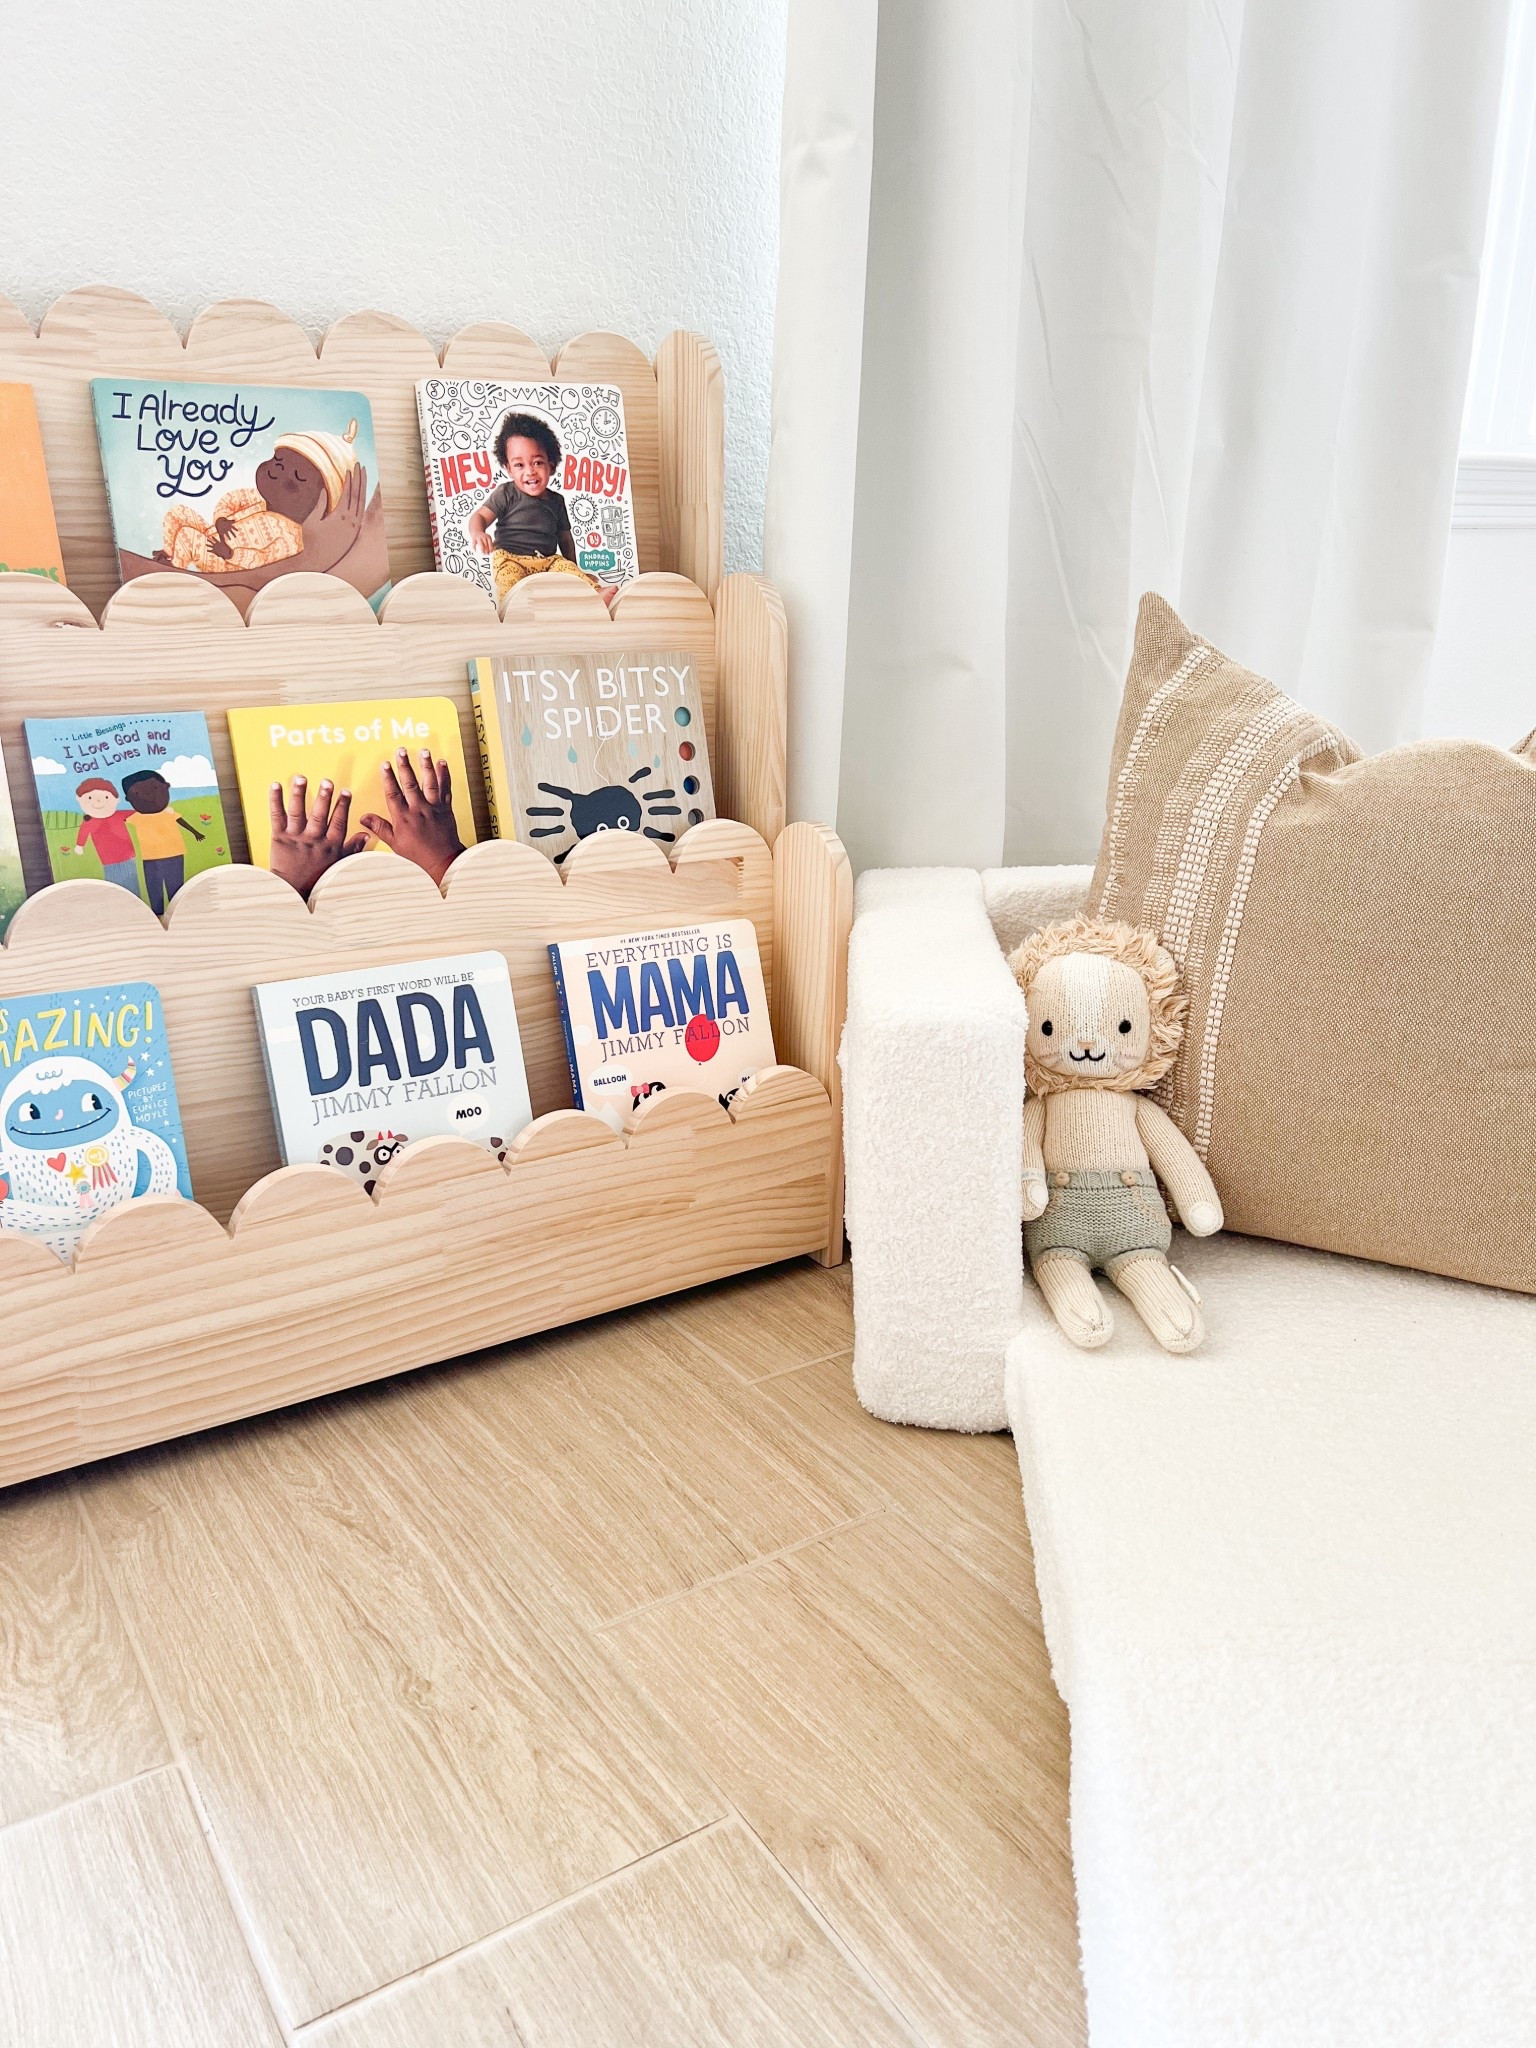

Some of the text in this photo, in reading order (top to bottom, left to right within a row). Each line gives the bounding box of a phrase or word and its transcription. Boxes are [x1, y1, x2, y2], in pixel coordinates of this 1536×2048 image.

[112, 391, 132, 419] I
[139, 390, 275, 447] Already
[137, 424, 220, 454] Love
[156, 454, 233, 498] You
[440, 450, 627, 502] HEY, BABY!
[589, 534, 599, 545] BY
[502, 665, 690, 703] ITSY BITSY
[72, 722, 126, 741] Little Blessings
[269, 717, 430, 748] Parts of Me
[543, 703, 667, 740] SPIDER
[63, 729, 170, 759] I Love God and
[73, 743, 166, 773] God Loves Me
[474, 704, 486, 746] ITSY
[480, 753, 495, 807] BITSY
[585, 933, 733, 969] EVERYTHING IS
[292, 972, 475, 1008] YOUR BABY'S FIRST WORD WILL BE
[587, 950, 750, 1040] MAMA
[295, 984, 495, 1096] DADA
[601, 1032, 665, 1063] JIMMY
[673, 1017, 751, 1045] FALLON
[128, 1081, 167, 1099] PICTURES
[569, 1063, 578, 1095] MAMA
[593, 1074, 627, 1087] BALLOON
[132, 1098, 168, 1114] EUNICE
[143, 1094, 153, 1103] BY
[311, 1066, 498, 1126] JIMMY FALLON
[136, 1108, 168, 1123] MOYLE
[455, 1106, 482, 1119] MOO
